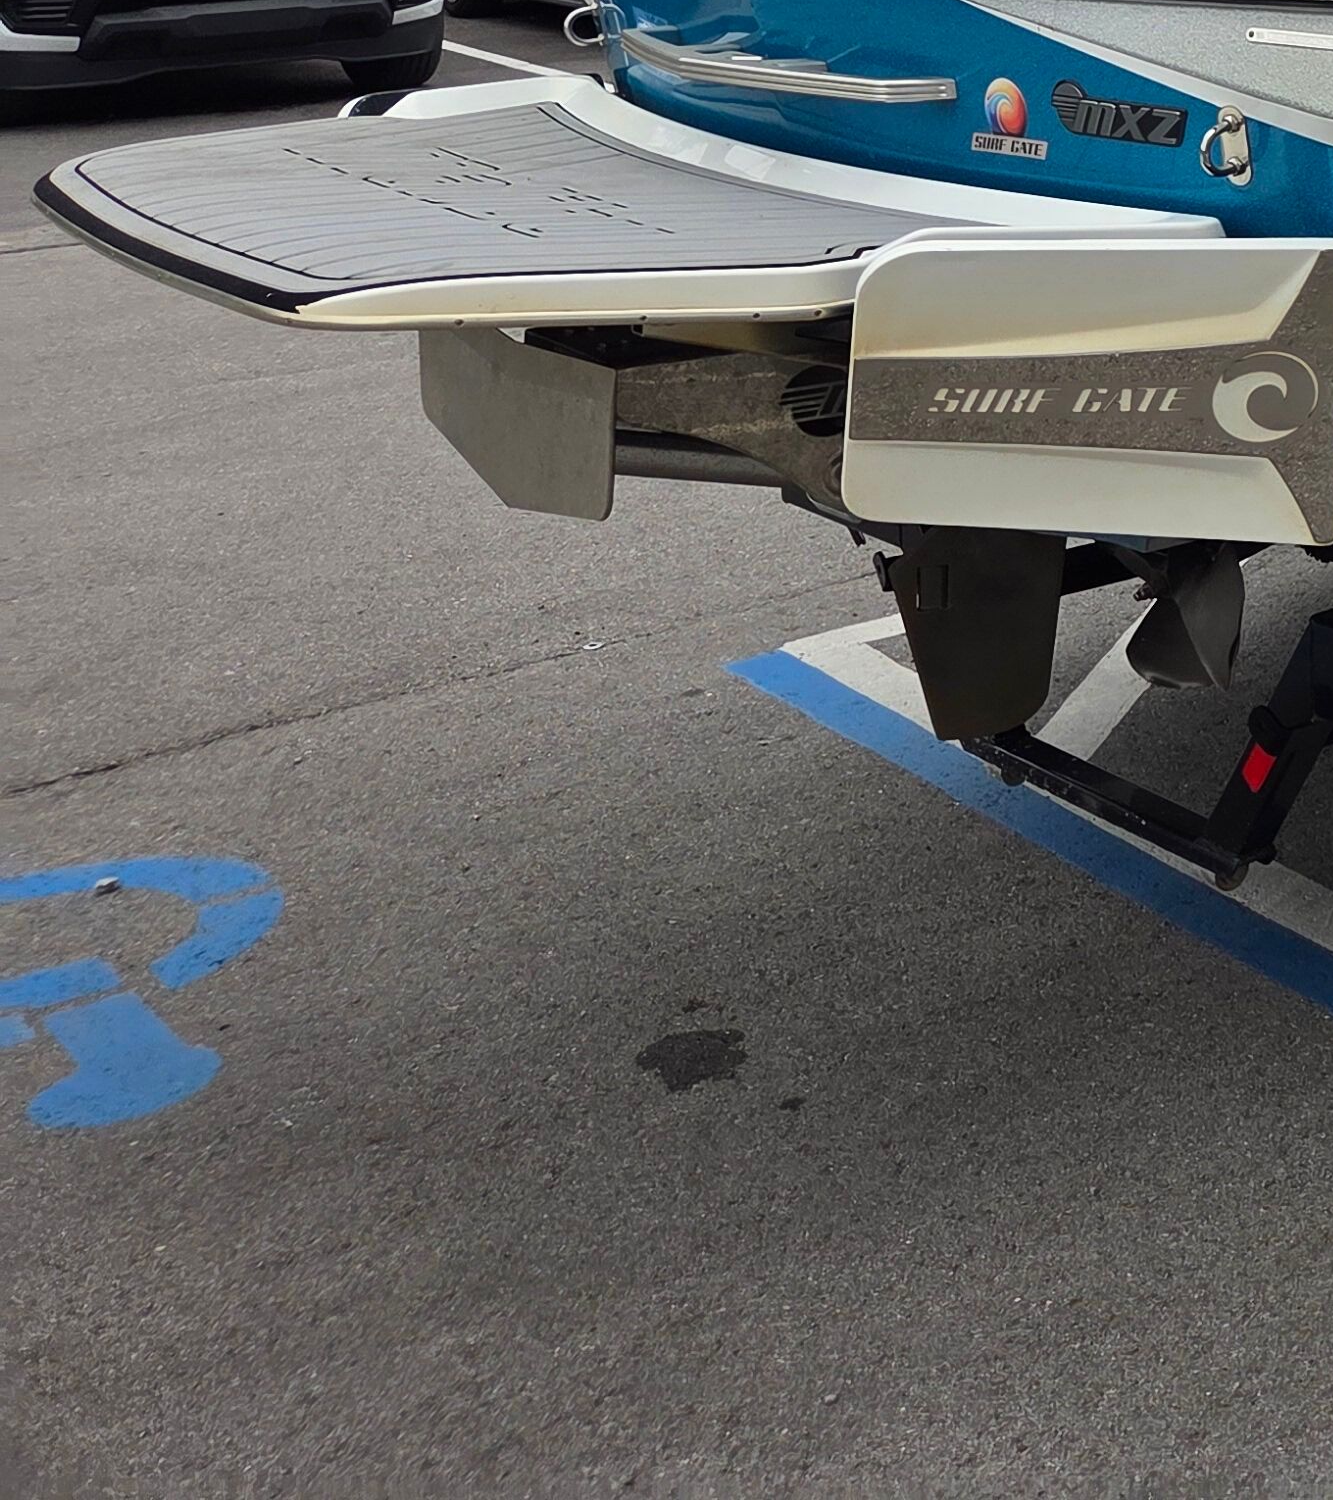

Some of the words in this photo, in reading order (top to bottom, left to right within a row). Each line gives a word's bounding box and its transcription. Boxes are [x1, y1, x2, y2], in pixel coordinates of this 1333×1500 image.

[974, 135, 1007, 151] SURF
[1010, 139, 1043, 157] GATE
[928, 387, 1061, 413] SURF
[1072, 386, 1192, 413] GATE
